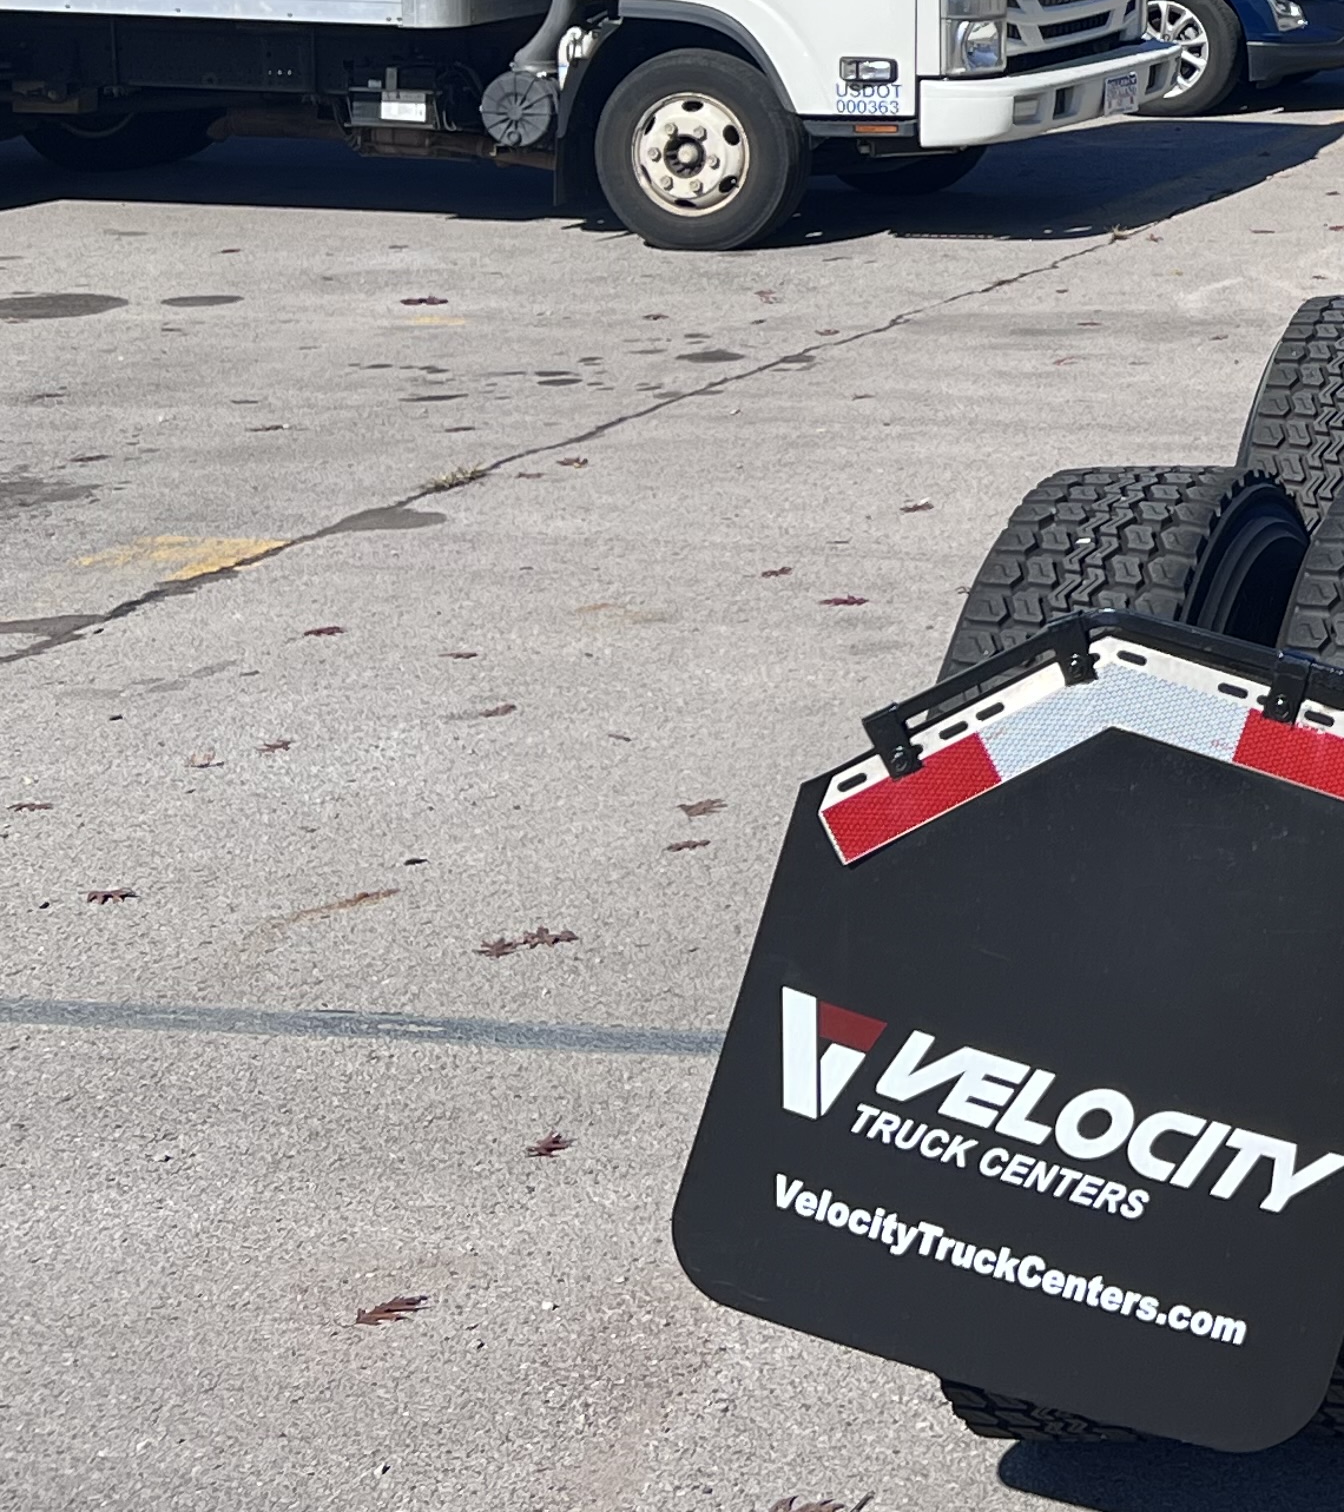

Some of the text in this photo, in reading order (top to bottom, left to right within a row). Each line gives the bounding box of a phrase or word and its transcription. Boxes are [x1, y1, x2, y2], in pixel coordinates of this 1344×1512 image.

[836, 83, 902, 98] USDOT
[836, 99, 899, 114] 000363
[850, 1103, 1150, 1219] TRUCK CENTERS
[776, 1173, 1247, 1345] VelocityTruckCenters.com
